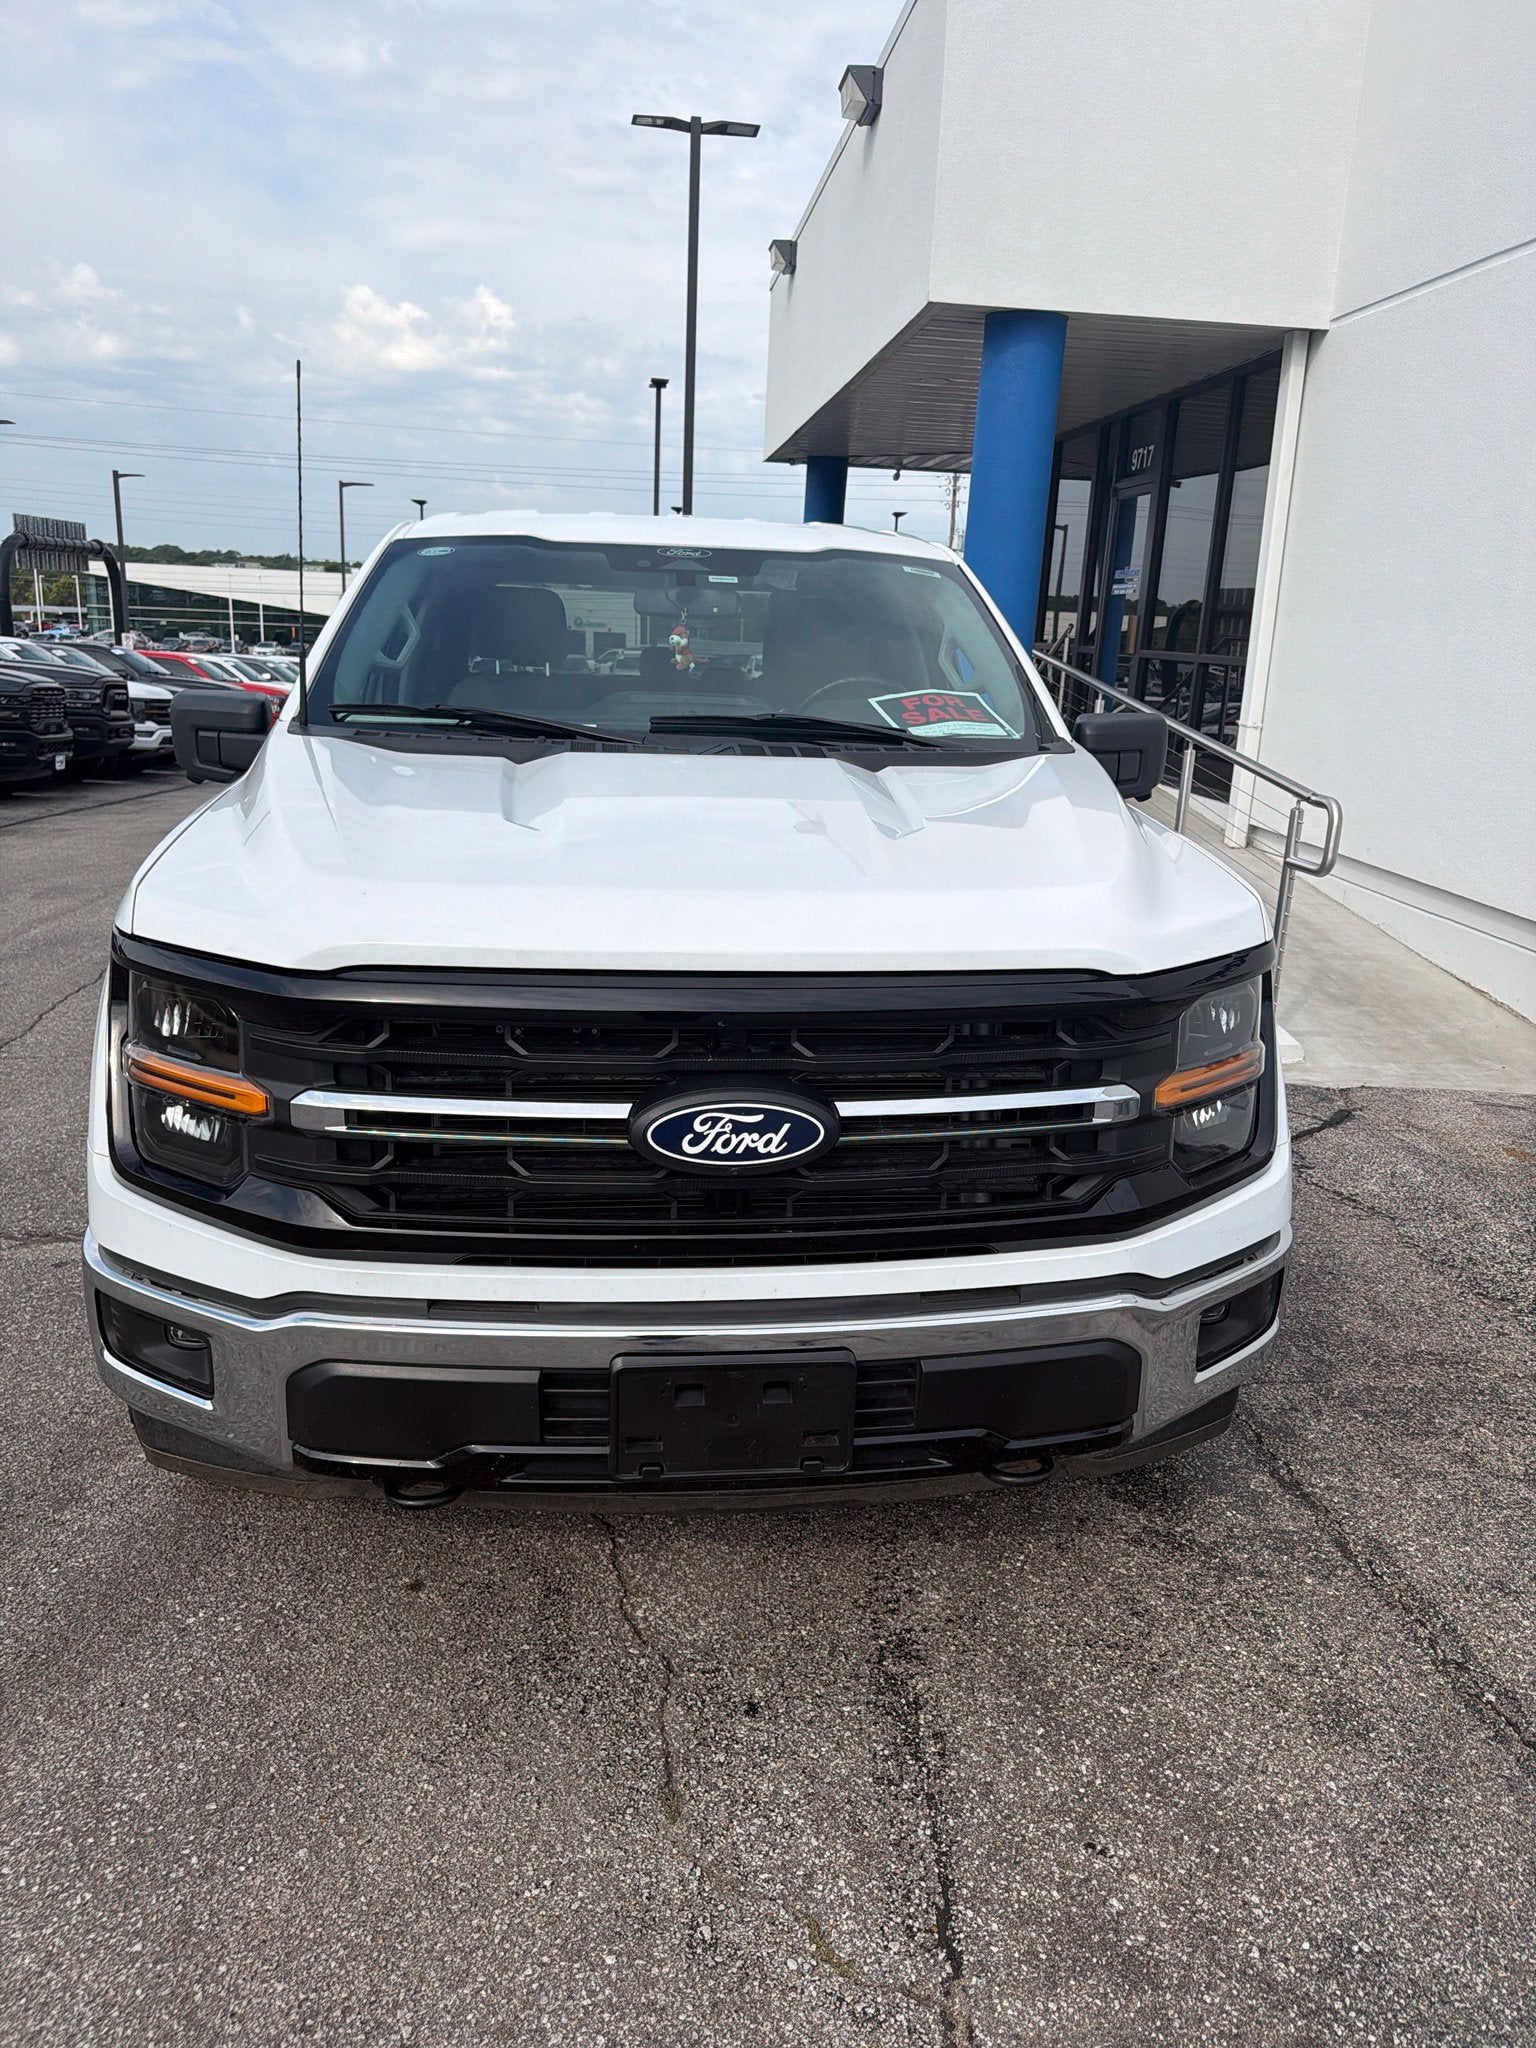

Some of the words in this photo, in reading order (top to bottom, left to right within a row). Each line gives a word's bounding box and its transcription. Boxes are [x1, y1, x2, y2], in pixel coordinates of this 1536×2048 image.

[1131, 445, 1155, 471] 9717
[666, 548, 702, 557] Ford
[901, 693, 965, 710] FOR
[901, 707, 990, 725] SALE
[682, 1112, 792, 1155] Ford
